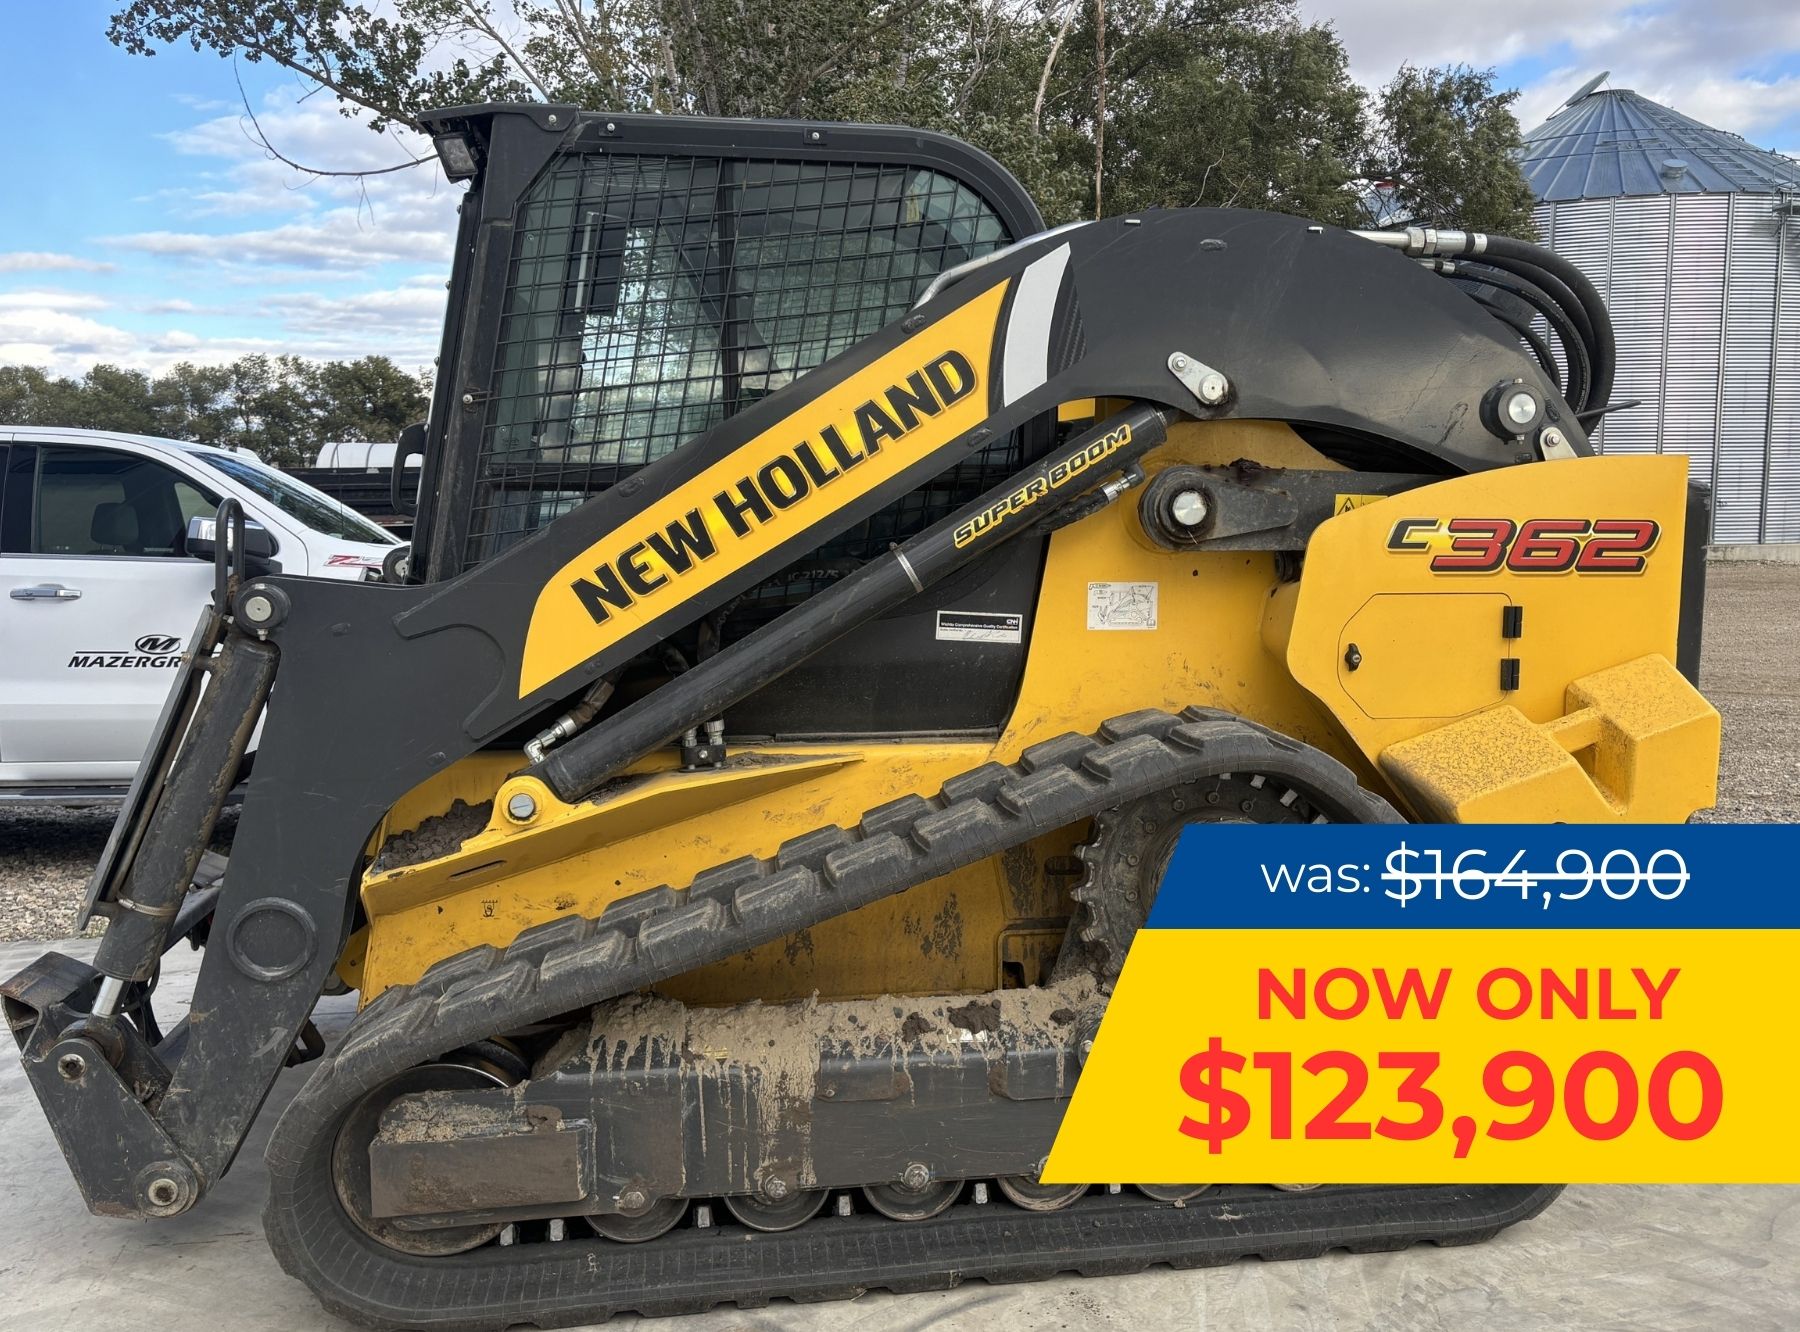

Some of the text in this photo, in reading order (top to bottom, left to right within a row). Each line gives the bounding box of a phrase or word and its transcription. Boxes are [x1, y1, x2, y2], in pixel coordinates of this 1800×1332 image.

[570, 350, 977, 625] NEW HOLLAND
[954, 424, 1132, 548] SUPER BOOM
